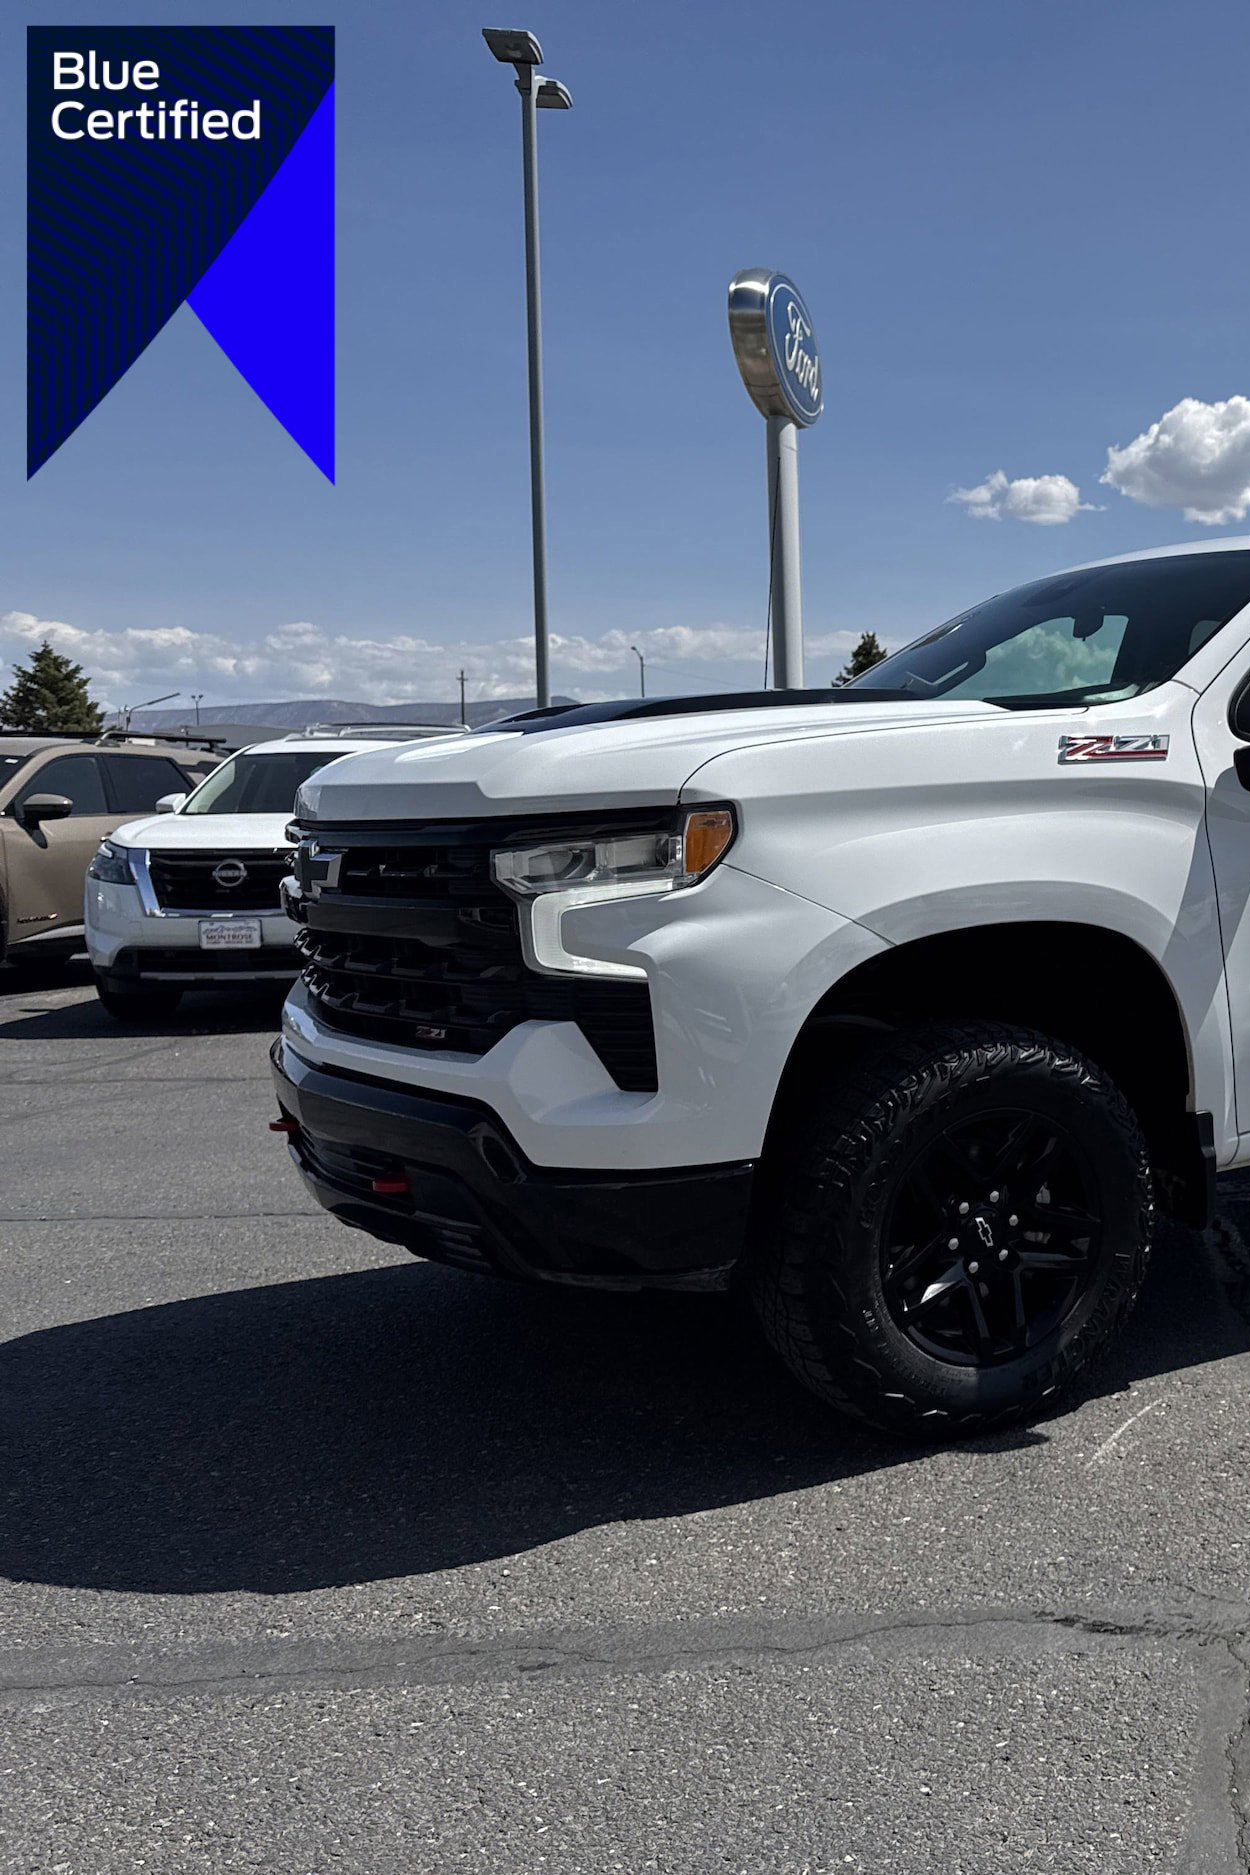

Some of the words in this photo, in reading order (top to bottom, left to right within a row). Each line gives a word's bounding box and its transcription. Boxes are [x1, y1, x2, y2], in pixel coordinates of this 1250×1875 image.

[785, 301, 819, 402] Ford
[1058, 734, 1170, 765] Z71
[206, 933, 253, 941] MONTROSE
[415, 1025, 447, 1040] Z71
